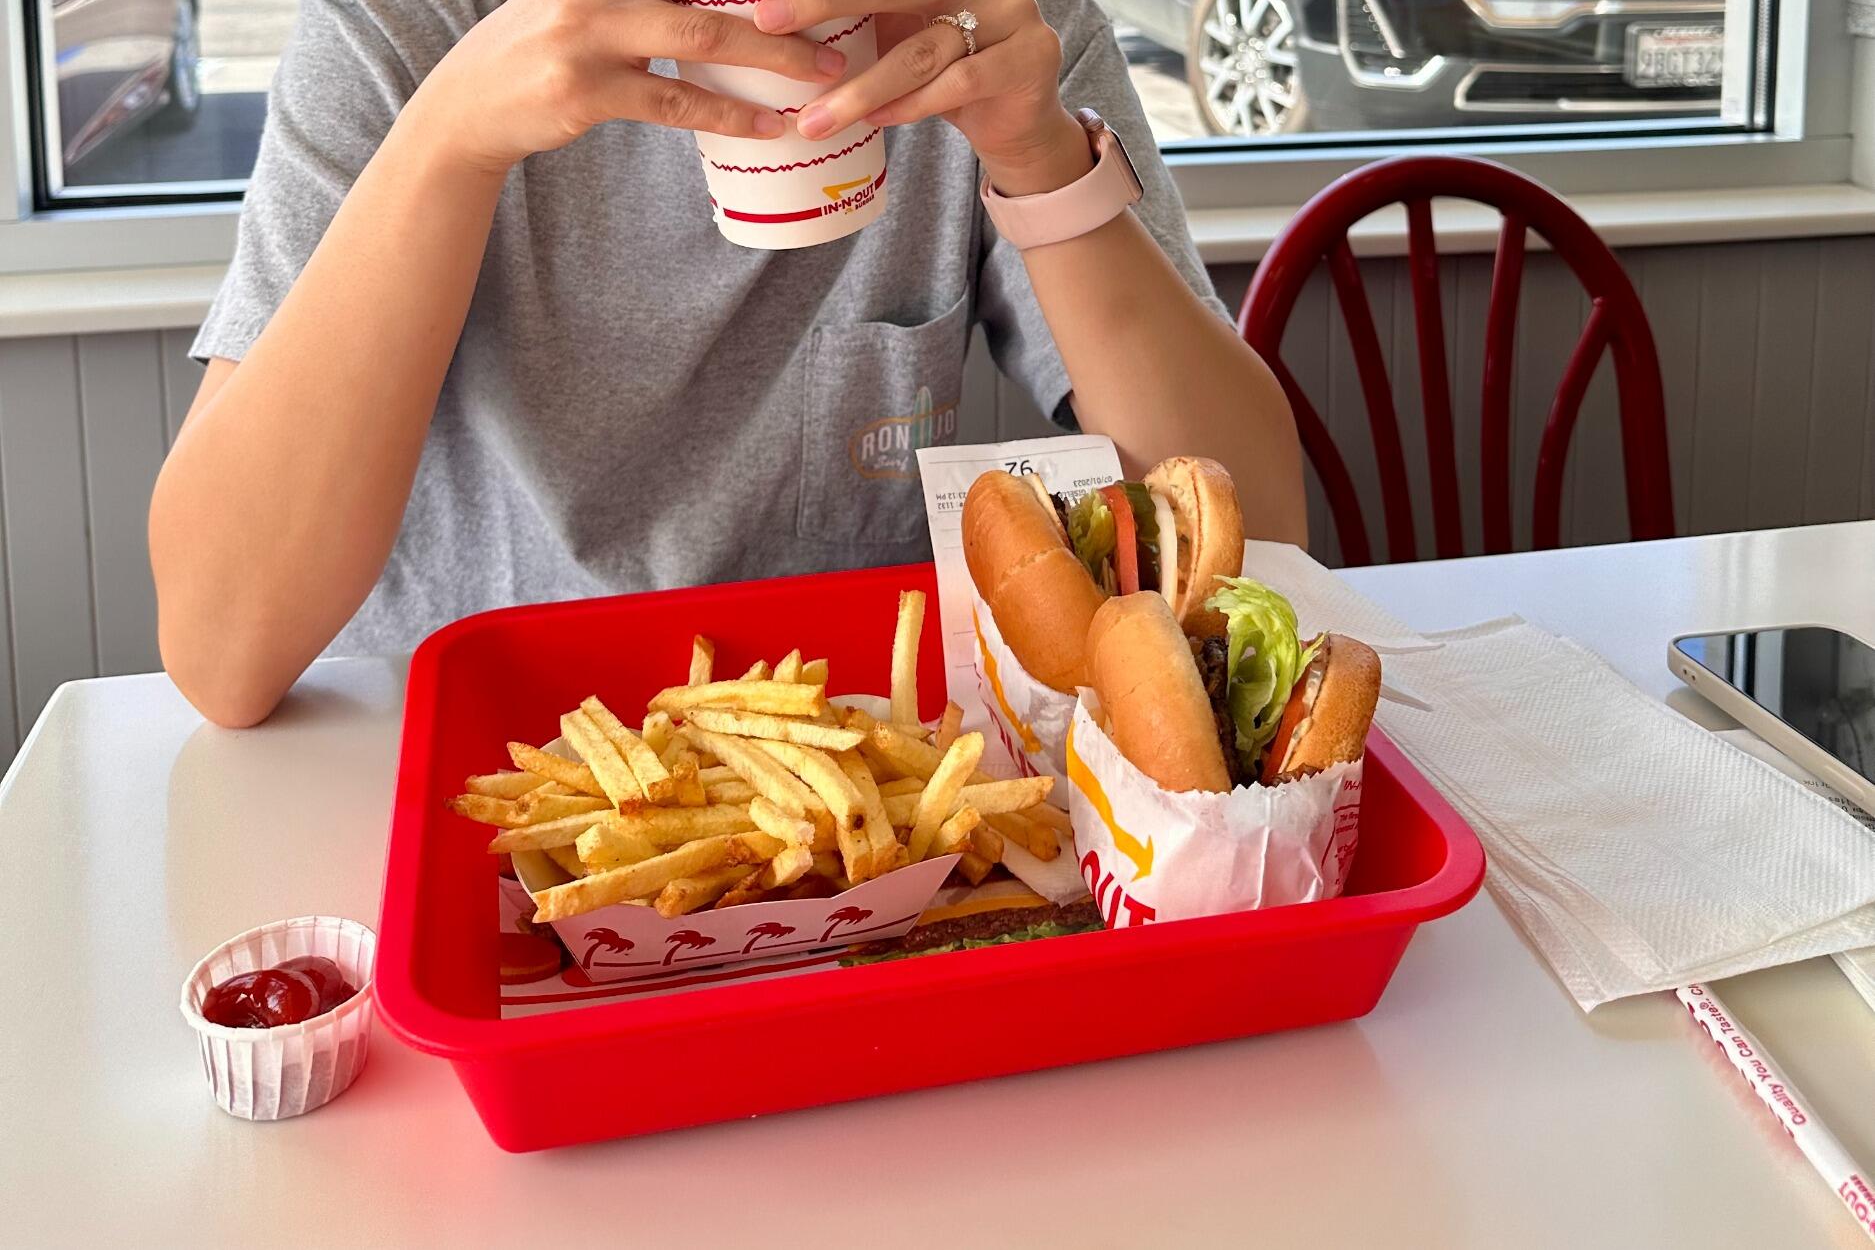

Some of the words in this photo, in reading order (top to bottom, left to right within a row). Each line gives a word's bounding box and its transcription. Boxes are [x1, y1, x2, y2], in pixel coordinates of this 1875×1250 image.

[823, 182, 874, 216] IN-N-OUT
[861, 424, 910, 461] RON
[1073, 475, 1113, 487] 07/01/2023
[1080, 849, 1156, 930] OUT
[1731, 1036, 1753, 1058] Can
[1749, 1059, 1772, 1083] You
[1768, 1083, 1807, 1126] Quality
